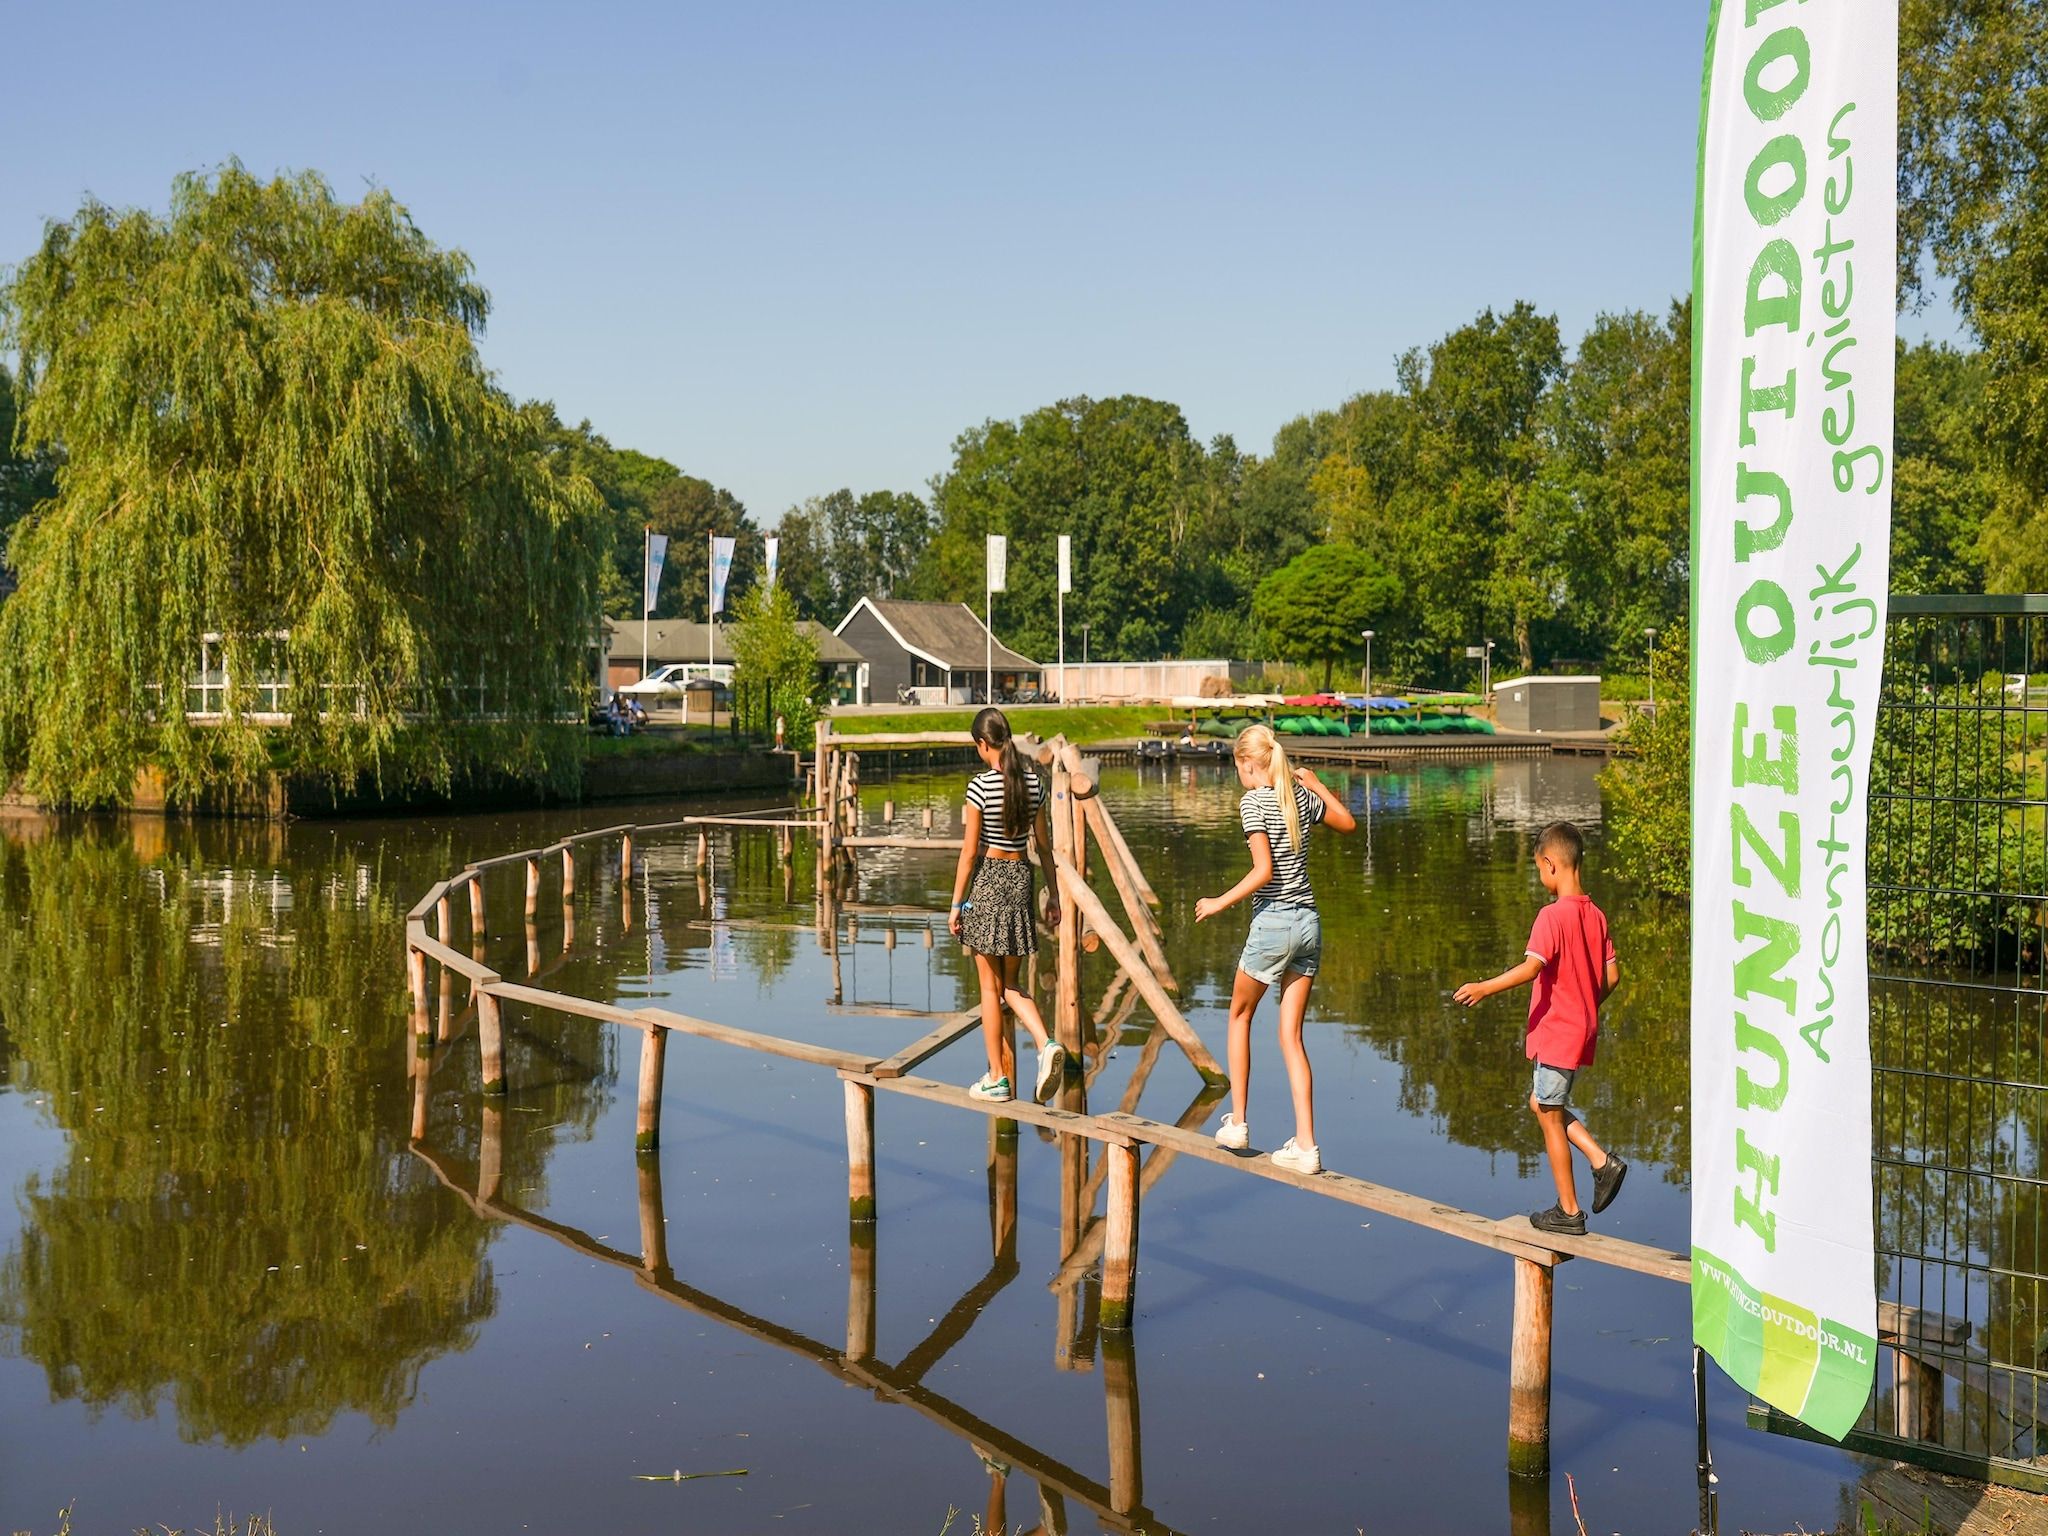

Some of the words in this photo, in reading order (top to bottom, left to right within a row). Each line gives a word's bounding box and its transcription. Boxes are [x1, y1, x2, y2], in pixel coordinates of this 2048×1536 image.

[1734, 0, 1811, 664] OUTDOO
[1807, 102, 1884, 494] genieten
[1730, 702, 1802, 1253] HUNZE
[1799, 543, 1878, 1063] Avontuurlijk
